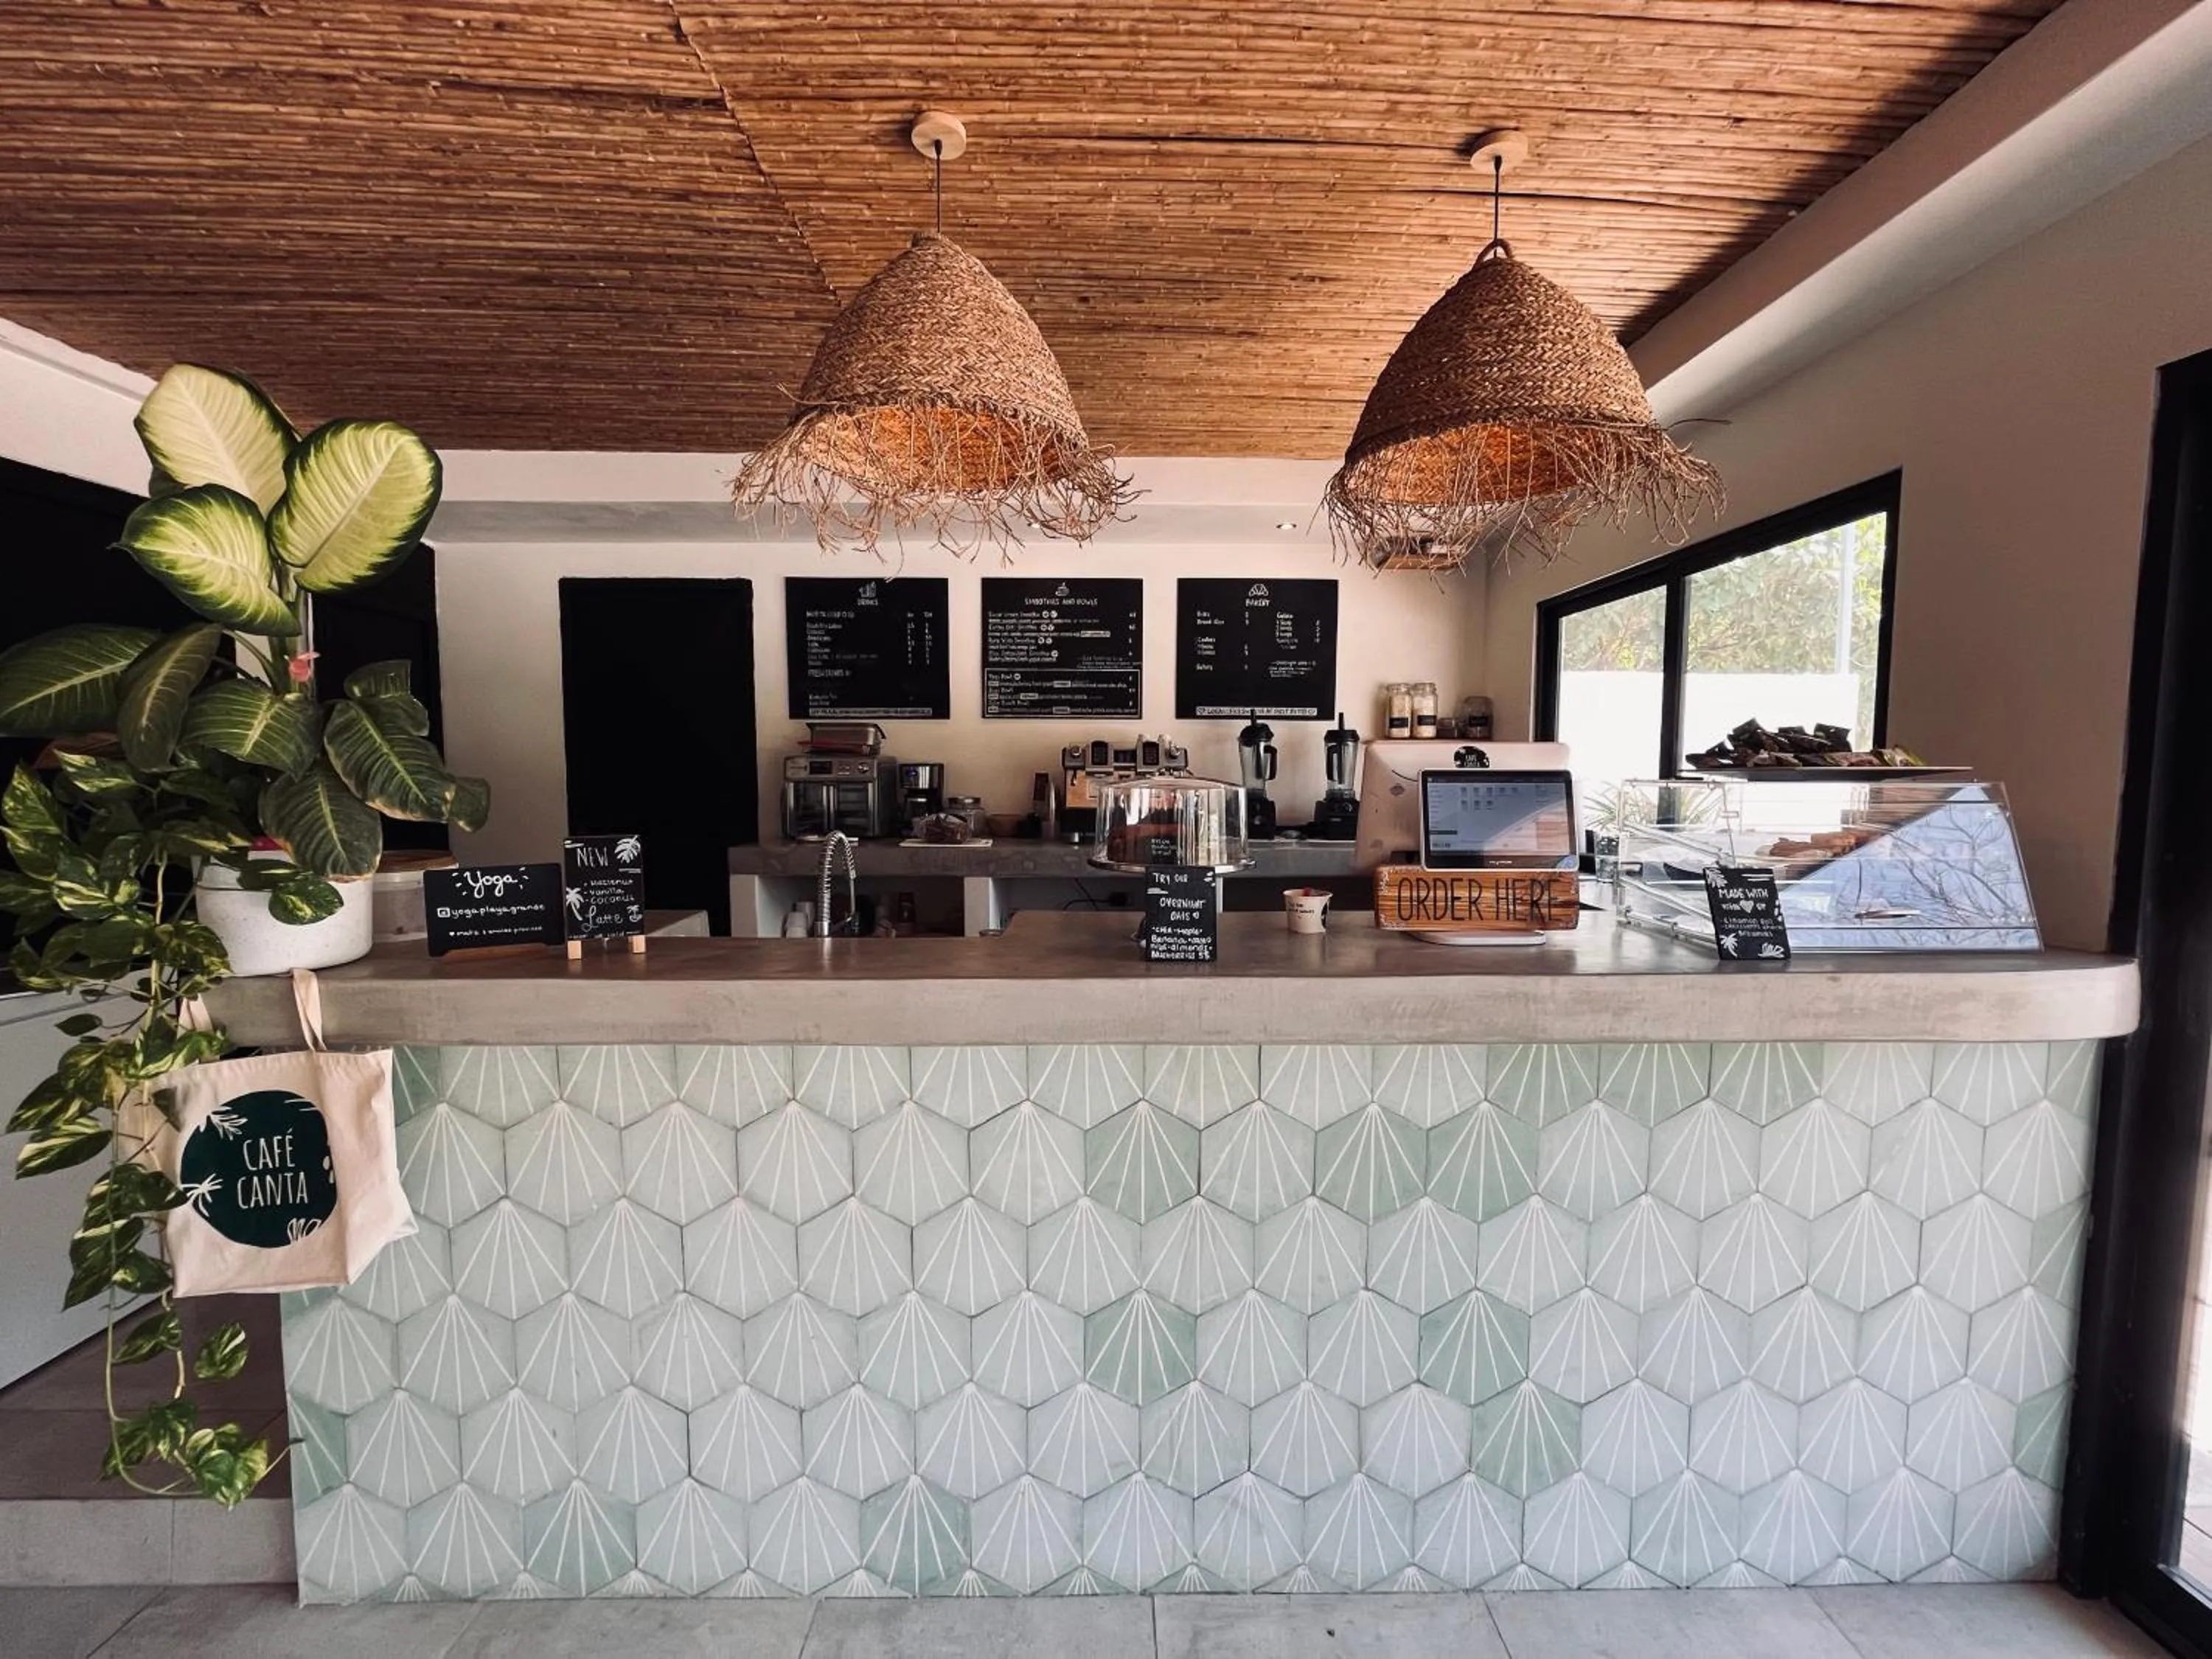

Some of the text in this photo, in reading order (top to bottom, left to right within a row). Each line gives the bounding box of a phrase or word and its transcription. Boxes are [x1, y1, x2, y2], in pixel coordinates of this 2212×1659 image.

[577, 846, 608, 867] NEW
[463, 871, 518, 899] Yoga
[1152, 872, 1188, 885] TRY OUR
[1397, 877, 1562, 922] ORDER HERE
[1719, 888, 1768, 898] MADE WITH
[451, 903, 546, 919] yogaplayagrande
[581, 905, 623, 932] Latte
[1170, 911, 1191, 922] OATS
[243, 1127, 296, 1171] CAFÉ
[237, 1172, 309, 1209] CANTA
